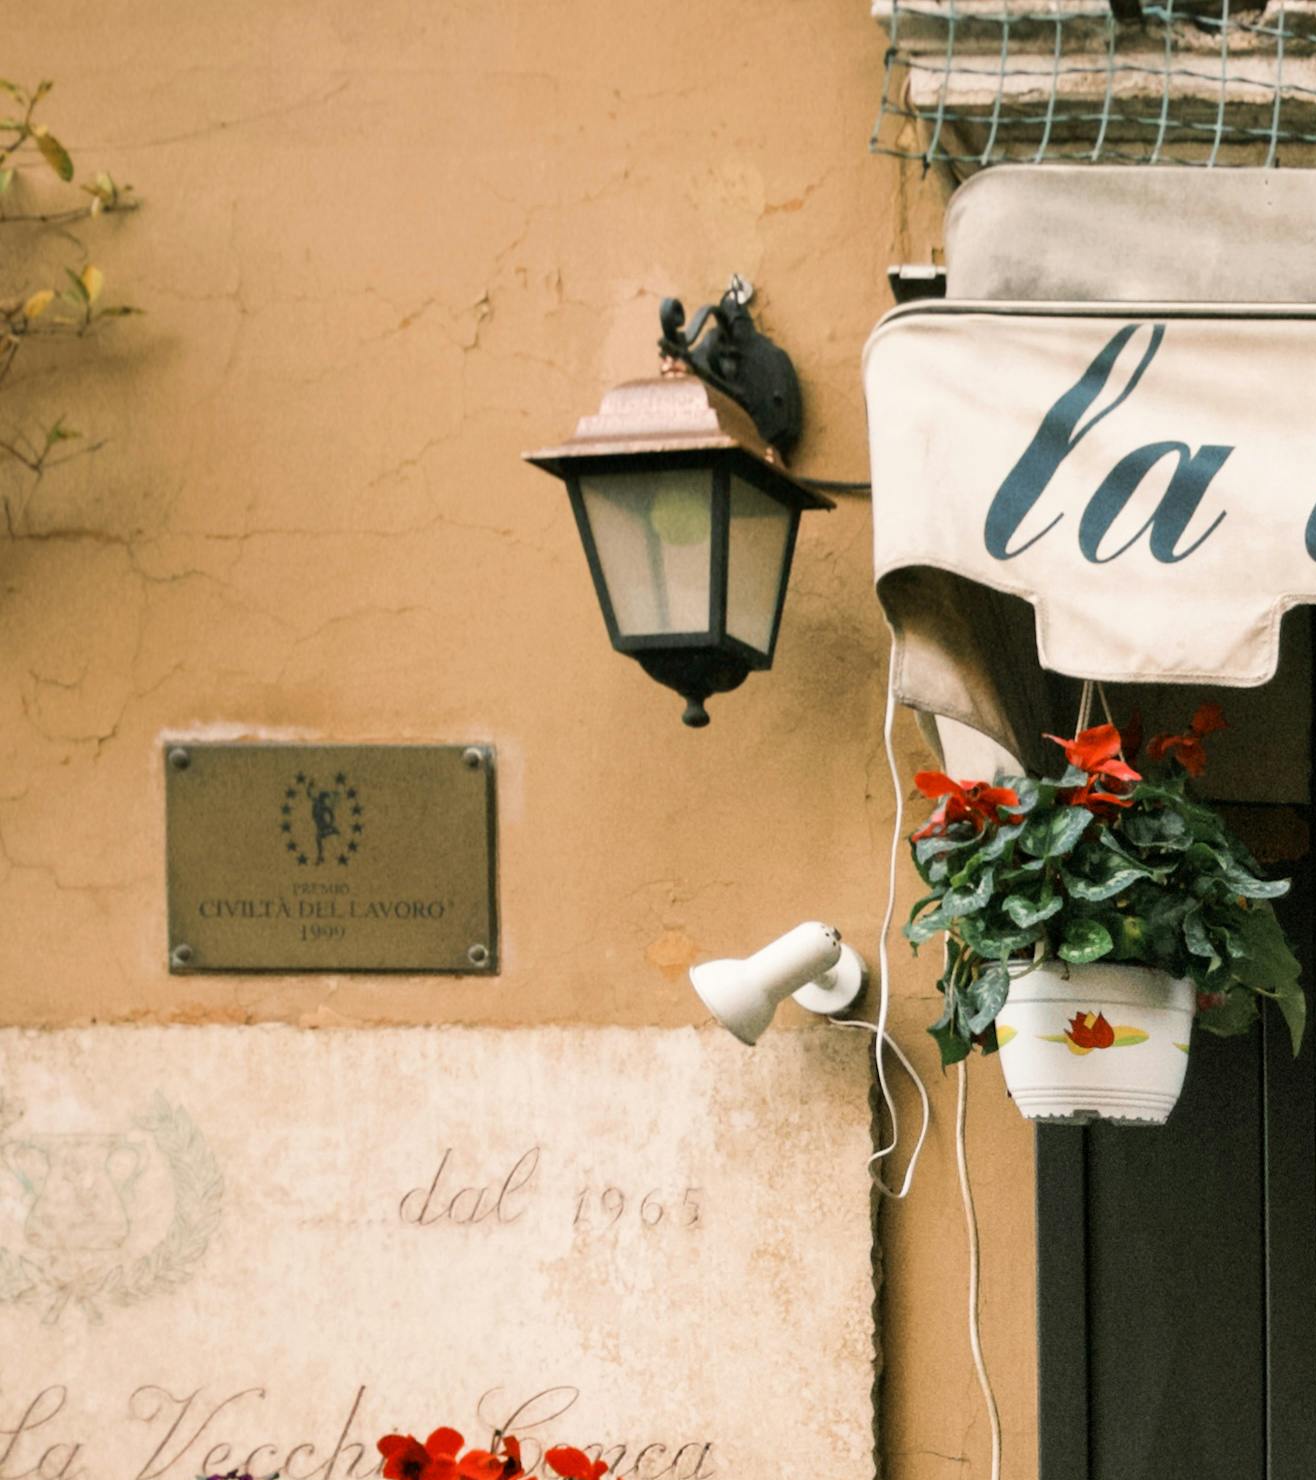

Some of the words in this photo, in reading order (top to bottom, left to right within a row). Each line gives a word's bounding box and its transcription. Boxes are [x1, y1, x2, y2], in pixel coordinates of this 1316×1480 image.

[984, 325, 1234, 564] la
[199, 896, 293, 920] CIVILTÀ
[299, 901, 340, 919] DEL
[349, 900, 445, 919] LAVORO
[399, 1147, 540, 1226] dal
[573, 1186, 702, 1226] 1965
